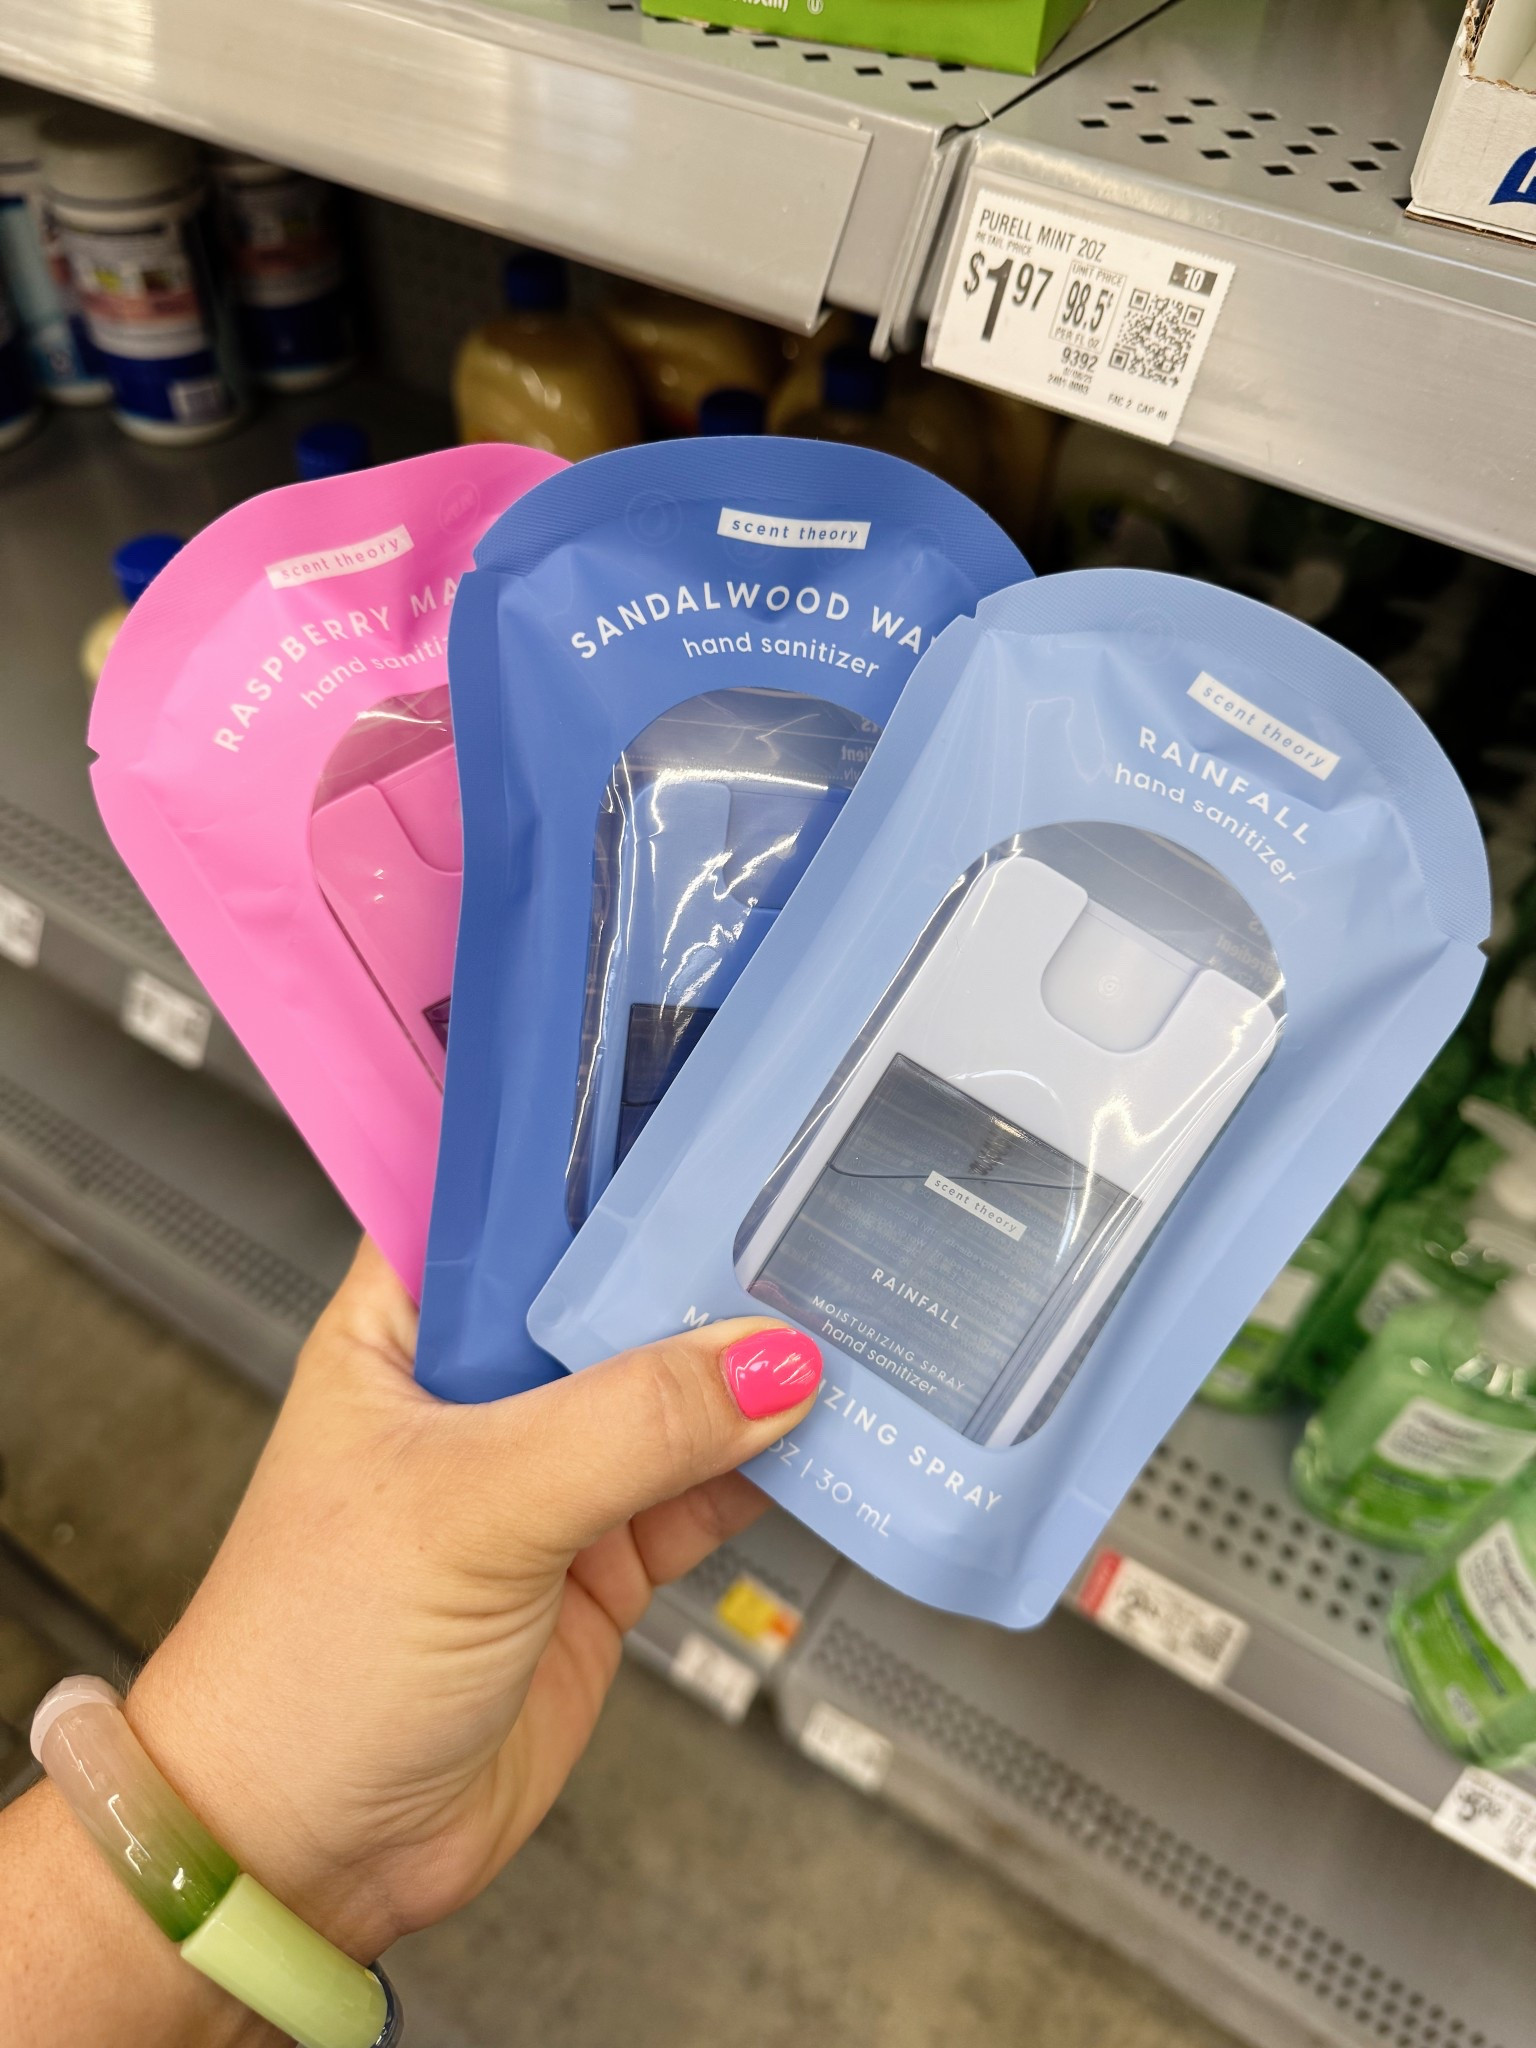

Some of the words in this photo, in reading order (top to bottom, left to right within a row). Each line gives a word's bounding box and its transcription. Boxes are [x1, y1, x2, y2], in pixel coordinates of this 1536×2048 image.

[975, 231, 1004, 248] RETAIL
[1006, 240, 1033, 257] PRICE
[979, 208, 1032, 241] PURELL
[1037, 225, 1076, 254] MINT
[1072, 264, 1095, 277] UNIT
[1096, 270, 1123, 287] PRICE
[1054, 326, 1072, 340] PER
[1074, 331, 1085, 345] FL
[1061, 346, 1099, 373] 9392
[281, 559, 330, 580] scent
[334, 537, 399, 568] theory
[732, 517, 790, 539] scent
[798, 525, 859, 544] theory
[571, 580, 849, 660] SANDALWOOD
[871, 605, 936, 655] WA
[213, 605, 391, 753] RASPBERRY
[409, 577, 458, 618] MA
[301, 656, 368, 710] hand
[370, 635, 448, 670] saniti
[682, 632, 752, 658] hand
[761, 635, 880, 679] sanitizer
[1203, 685, 1256, 726] scent
[1261, 722, 1325, 768] theory
[1139, 726, 1310, 845] RAINFALL
[1115, 762, 1186, 804] hand
[1192, 799, 1297, 885] sanitizer
[934, 1178, 970, 1204] scent
[973, 1201, 1019, 1234] theory
[871, 1267, 960, 1330] RAINFALL
[811, 1295, 916, 1362] MOISTURIZING
[920, 1358, 966, 1392] SPRAY
[821, 1318, 866, 1354] hand
[867, 1347, 938, 1397] sanitizer
[816, 1469, 853, 1503] 30
[856, 1501, 894, 1538] mL
[908, 1445, 1003, 1513] SPRAY
